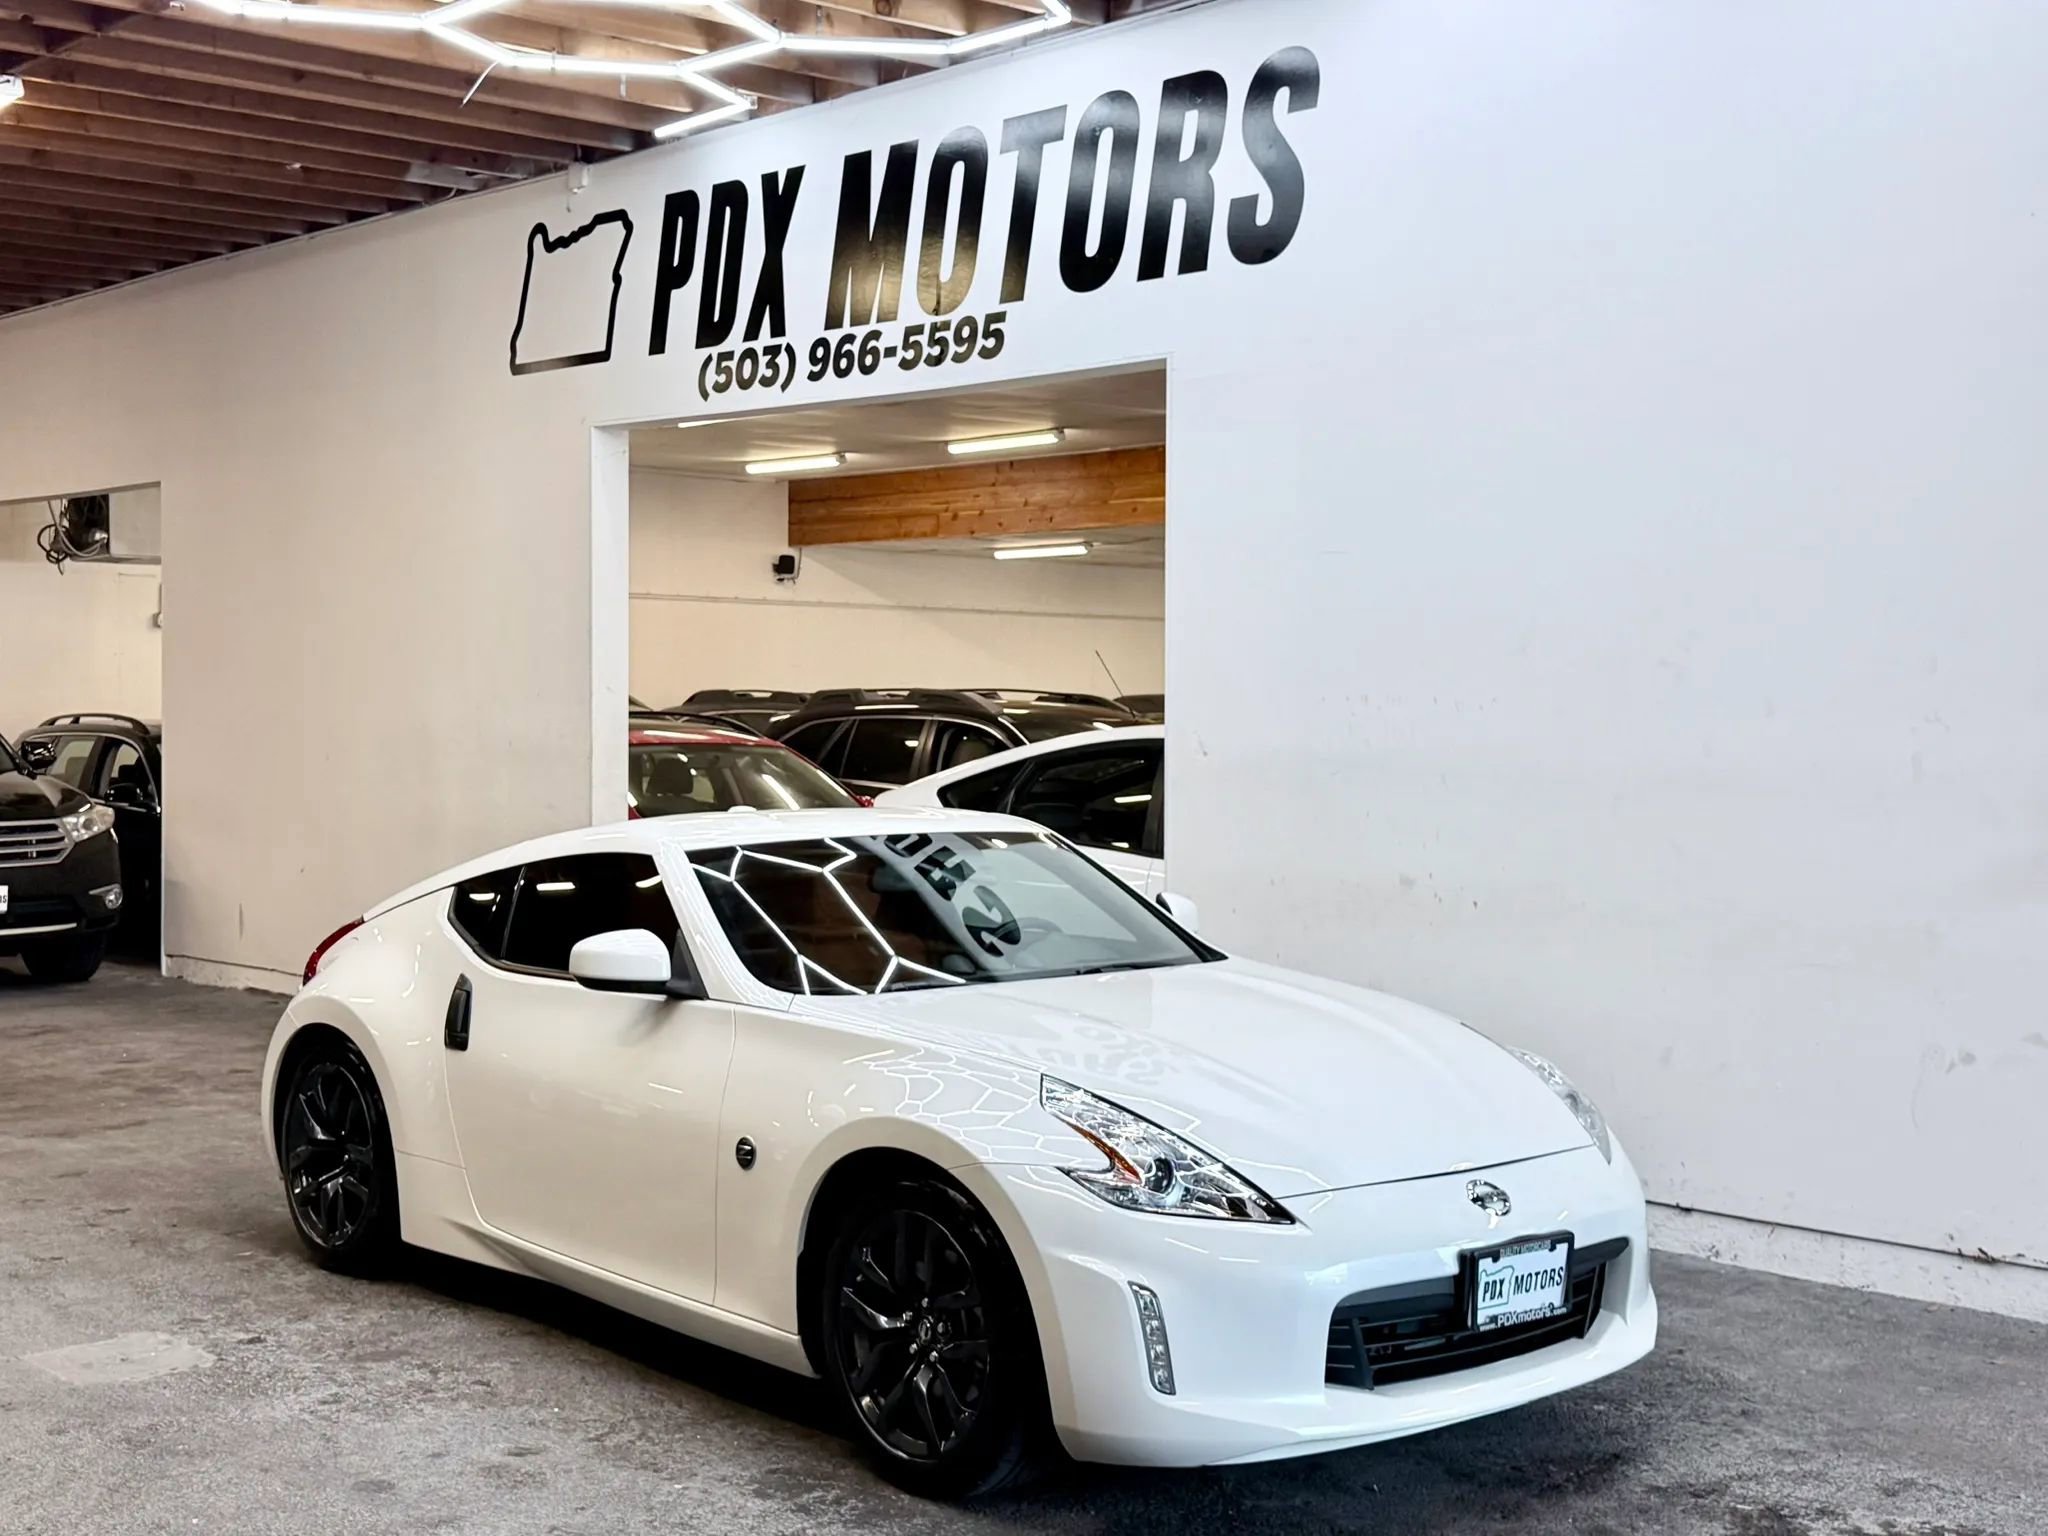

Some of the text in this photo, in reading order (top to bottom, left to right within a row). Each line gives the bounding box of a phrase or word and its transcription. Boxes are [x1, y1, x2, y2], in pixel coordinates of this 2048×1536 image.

[648, 45, 1320, 356] PDX MOTORS
[698, 311, 1007, 401] (503) 966-5595
[1482, 1266, 1564, 1303] PDX MOTORS
